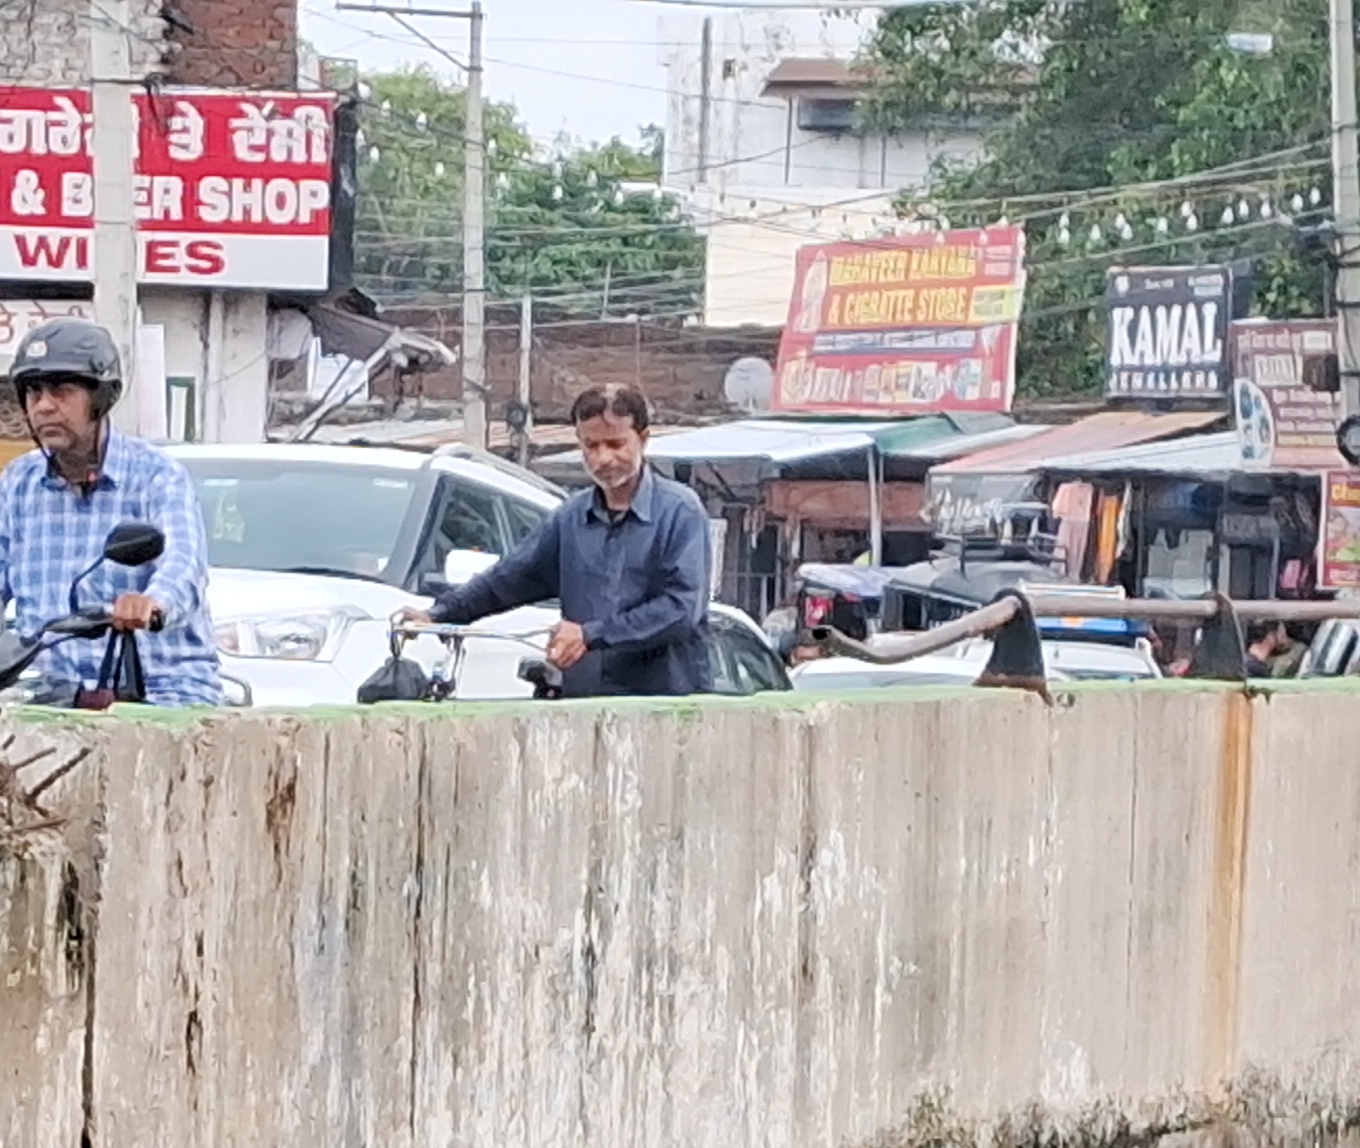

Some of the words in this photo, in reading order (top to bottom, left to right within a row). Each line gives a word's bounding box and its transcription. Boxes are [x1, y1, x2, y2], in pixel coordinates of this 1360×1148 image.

[168, 100, 204, 161] ਤੇ
[12, 169, 46, 216] &
[61, 172, 183, 221] BER
[198, 176, 330, 224] SHOP
[14, 234, 224, 275] WIES
[1110, 301, 1223, 366] KAMAL
